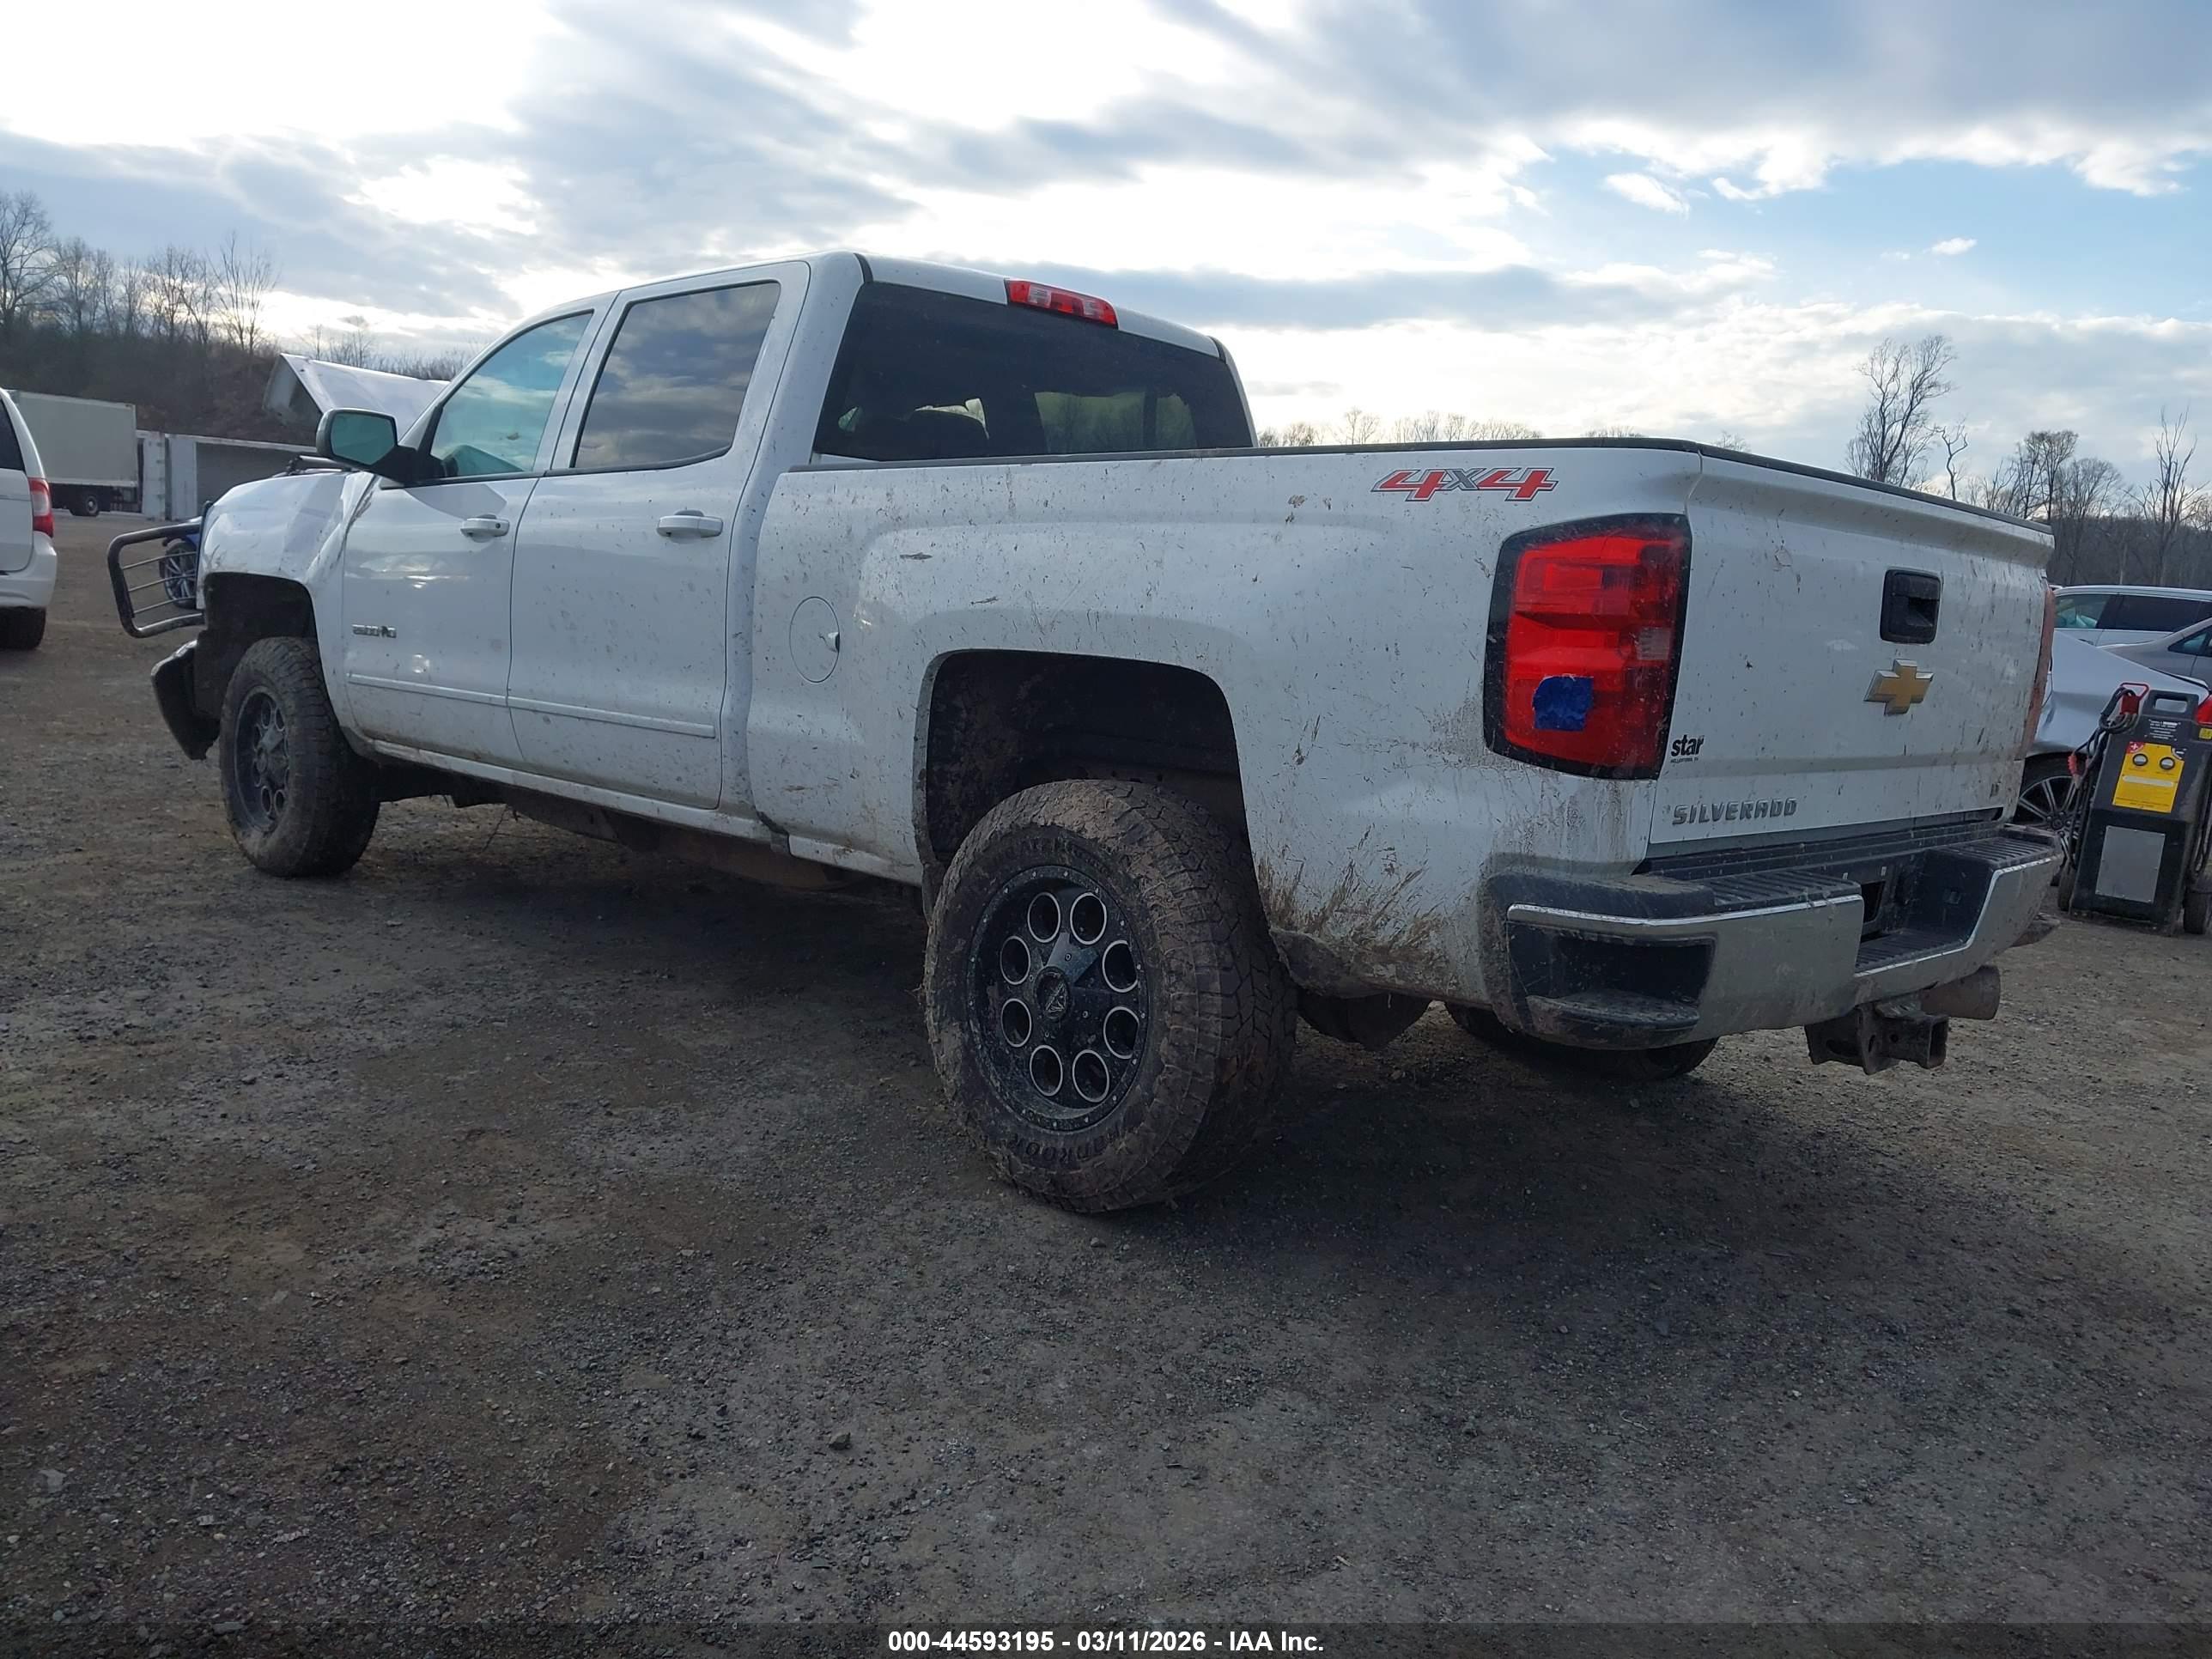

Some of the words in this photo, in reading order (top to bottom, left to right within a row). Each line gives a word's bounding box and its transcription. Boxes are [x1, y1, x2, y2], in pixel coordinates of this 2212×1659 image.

[1370, 467, 1559, 501] 4X4
[1671, 734, 1705, 756] star
[1672, 798, 1798, 825] SILVERADO
